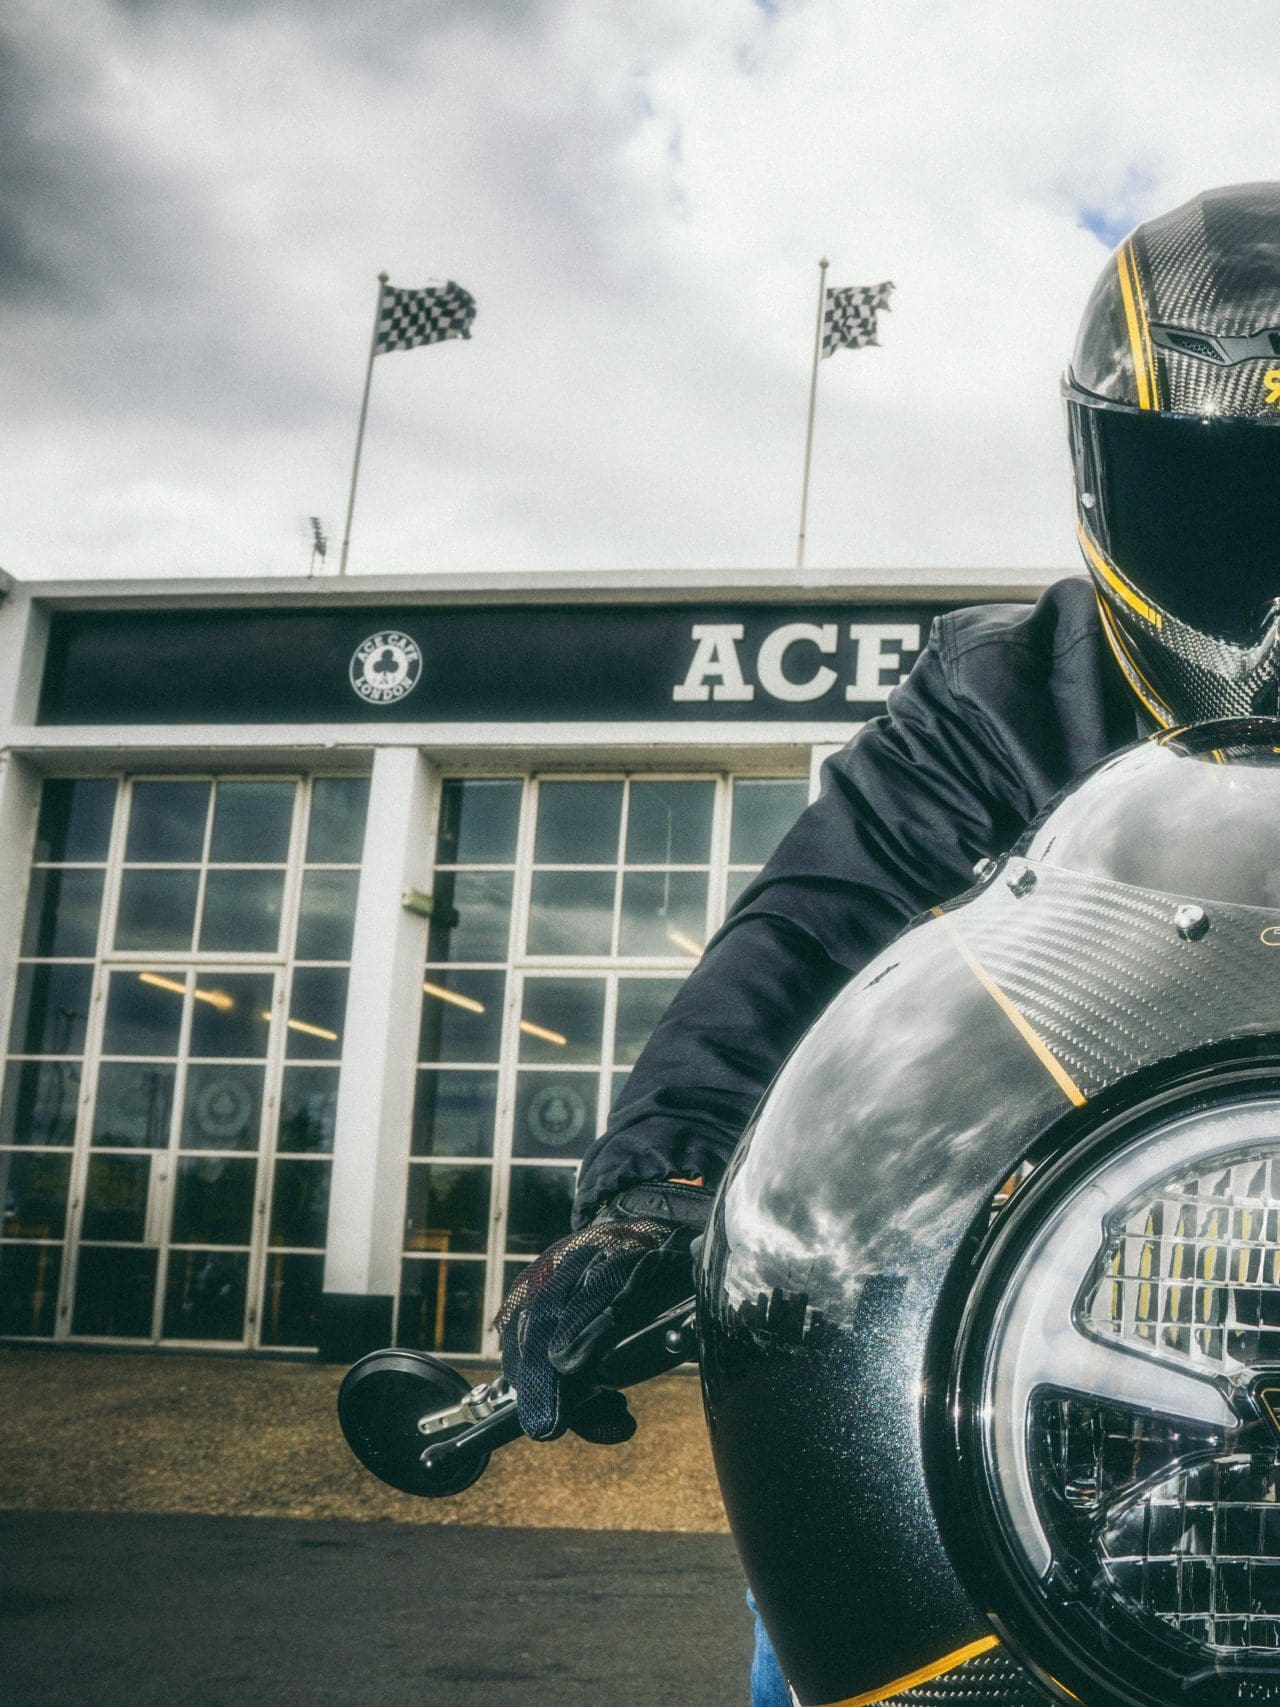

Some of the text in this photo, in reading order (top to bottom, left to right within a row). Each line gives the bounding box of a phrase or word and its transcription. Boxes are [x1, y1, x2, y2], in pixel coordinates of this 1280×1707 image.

[357, 634, 418, 663] ACE CAFE
[673, 623, 920, 702] ACE
[355, 676, 413, 701] LONDON
